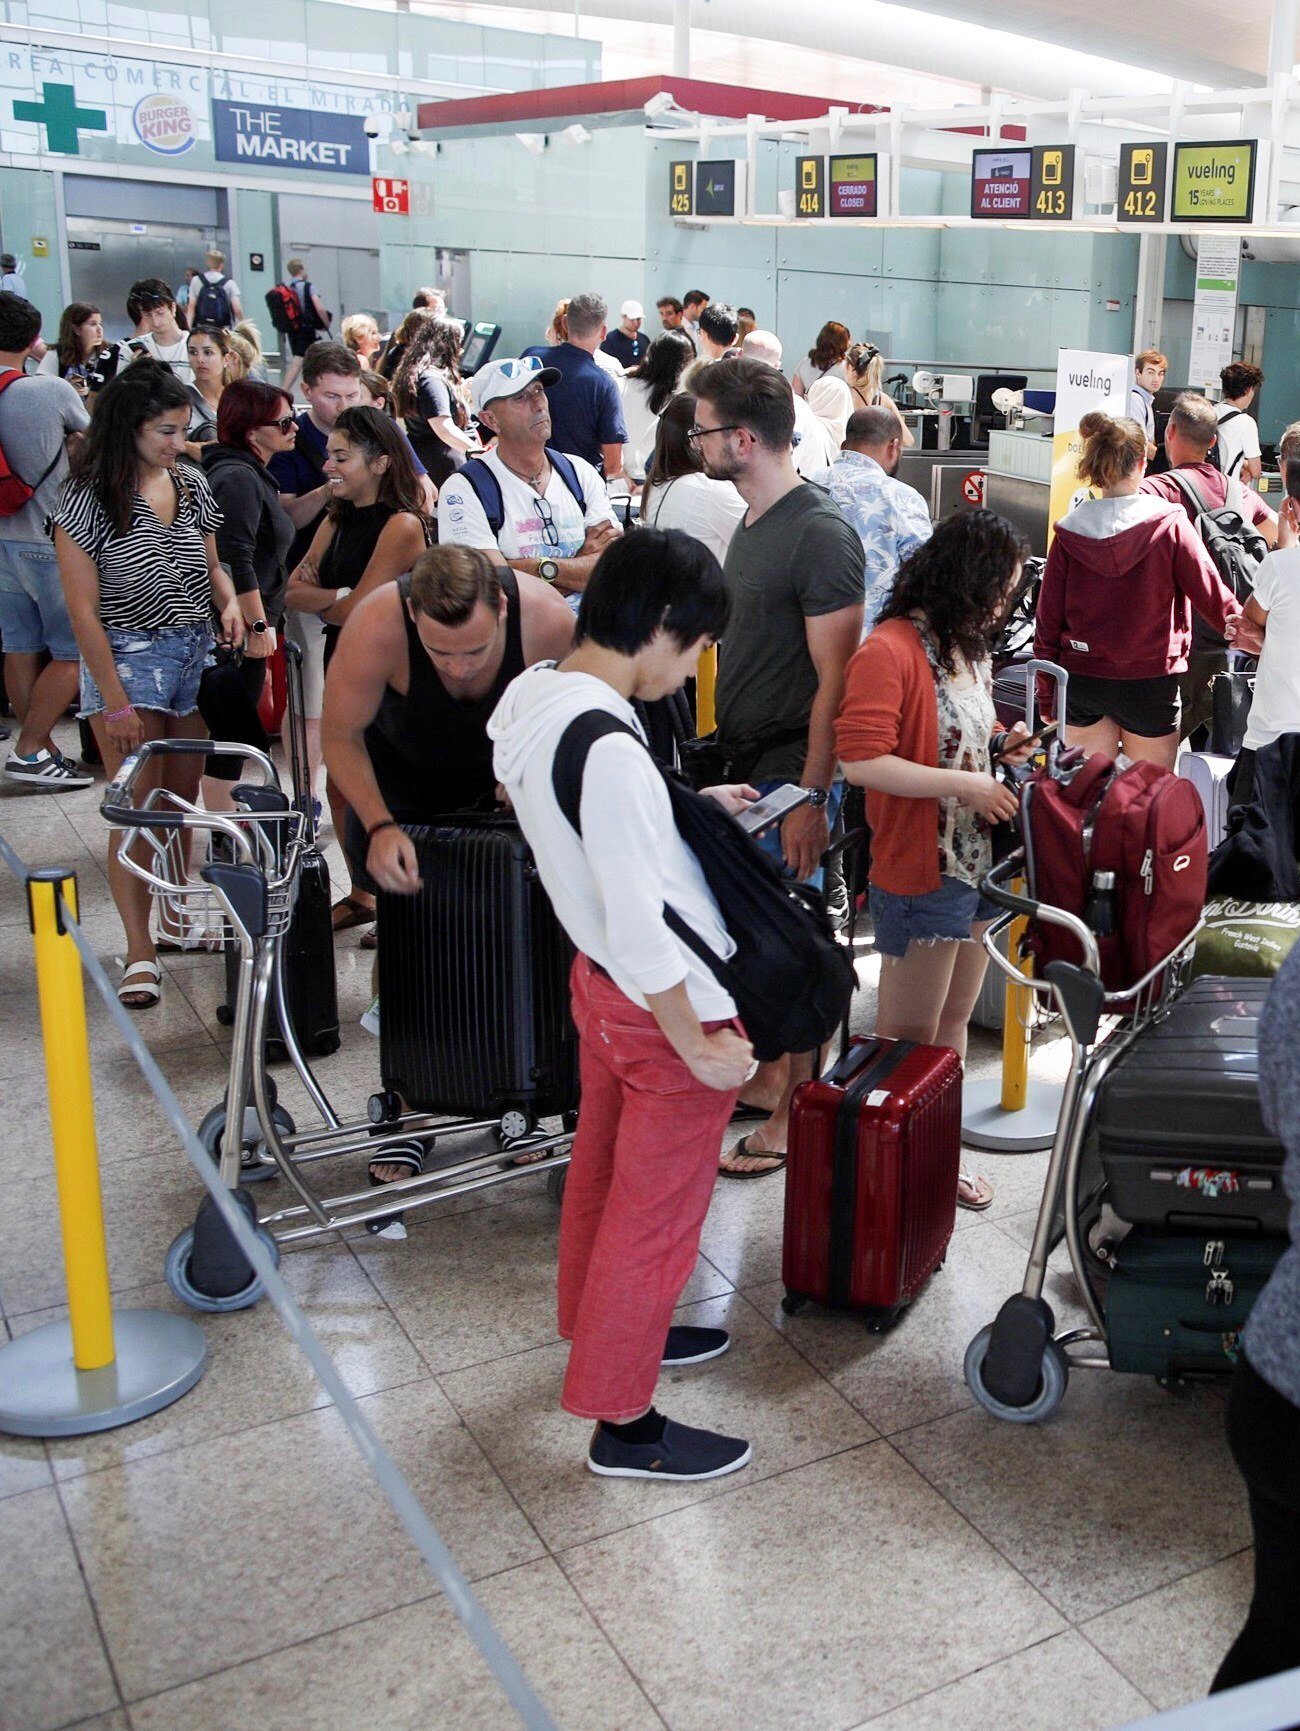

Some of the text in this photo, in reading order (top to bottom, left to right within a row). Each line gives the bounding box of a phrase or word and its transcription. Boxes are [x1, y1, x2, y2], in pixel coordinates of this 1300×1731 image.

[9, 52, 64, 75] REA
[310, 88, 410, 113] MIRADO
[139, 106, 189, 123] BURGER
[229, 107, 282, 135] THE
[142, 118, 192, 140] KING
[235, 133, 352, 166] MARKET
[1188, 158, 1236, 185] vueling
[838, 185, 867, 195] CERRADO
[984, 181, 1019, 194] ATENCIÓ
[1188, 189, 1199, 206] 15
[671, 194, 690, 212] 425
[800, 193, 819, 213] 414
[840, 198, 864, 207] CLOSED
[981, 197, 1022, 208] AL CLIENT
[1036, 190, 1065, 214] 413
[1124, 190, 1157, 216] 412
[1069, 368, 1112, 397] vueling
[1220, 927, 1282, 951] French West Indies
[1234, 940, 1260, 952] Gustavia
